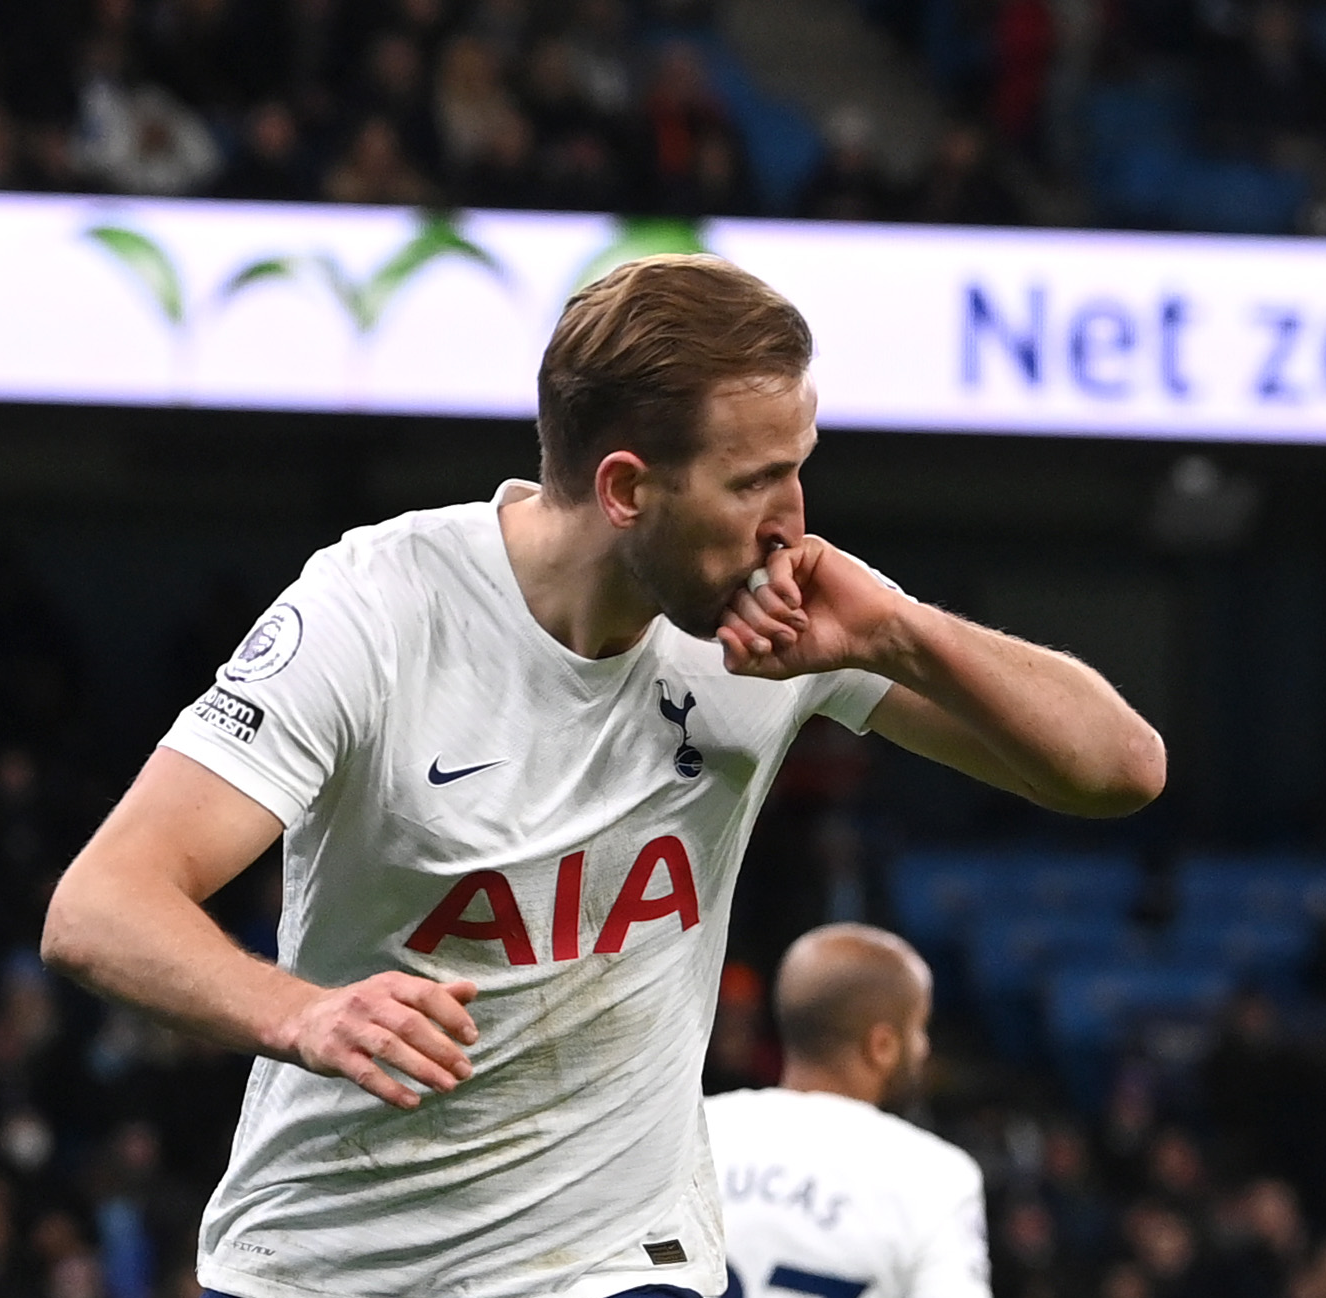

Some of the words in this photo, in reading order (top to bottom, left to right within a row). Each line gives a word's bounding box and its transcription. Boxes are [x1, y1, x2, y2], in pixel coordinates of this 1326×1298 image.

[960, 276, 1193, 397] Net
[404, 834, 701, 966] AIA
[725, 1164, 851, 1231] UCAS
